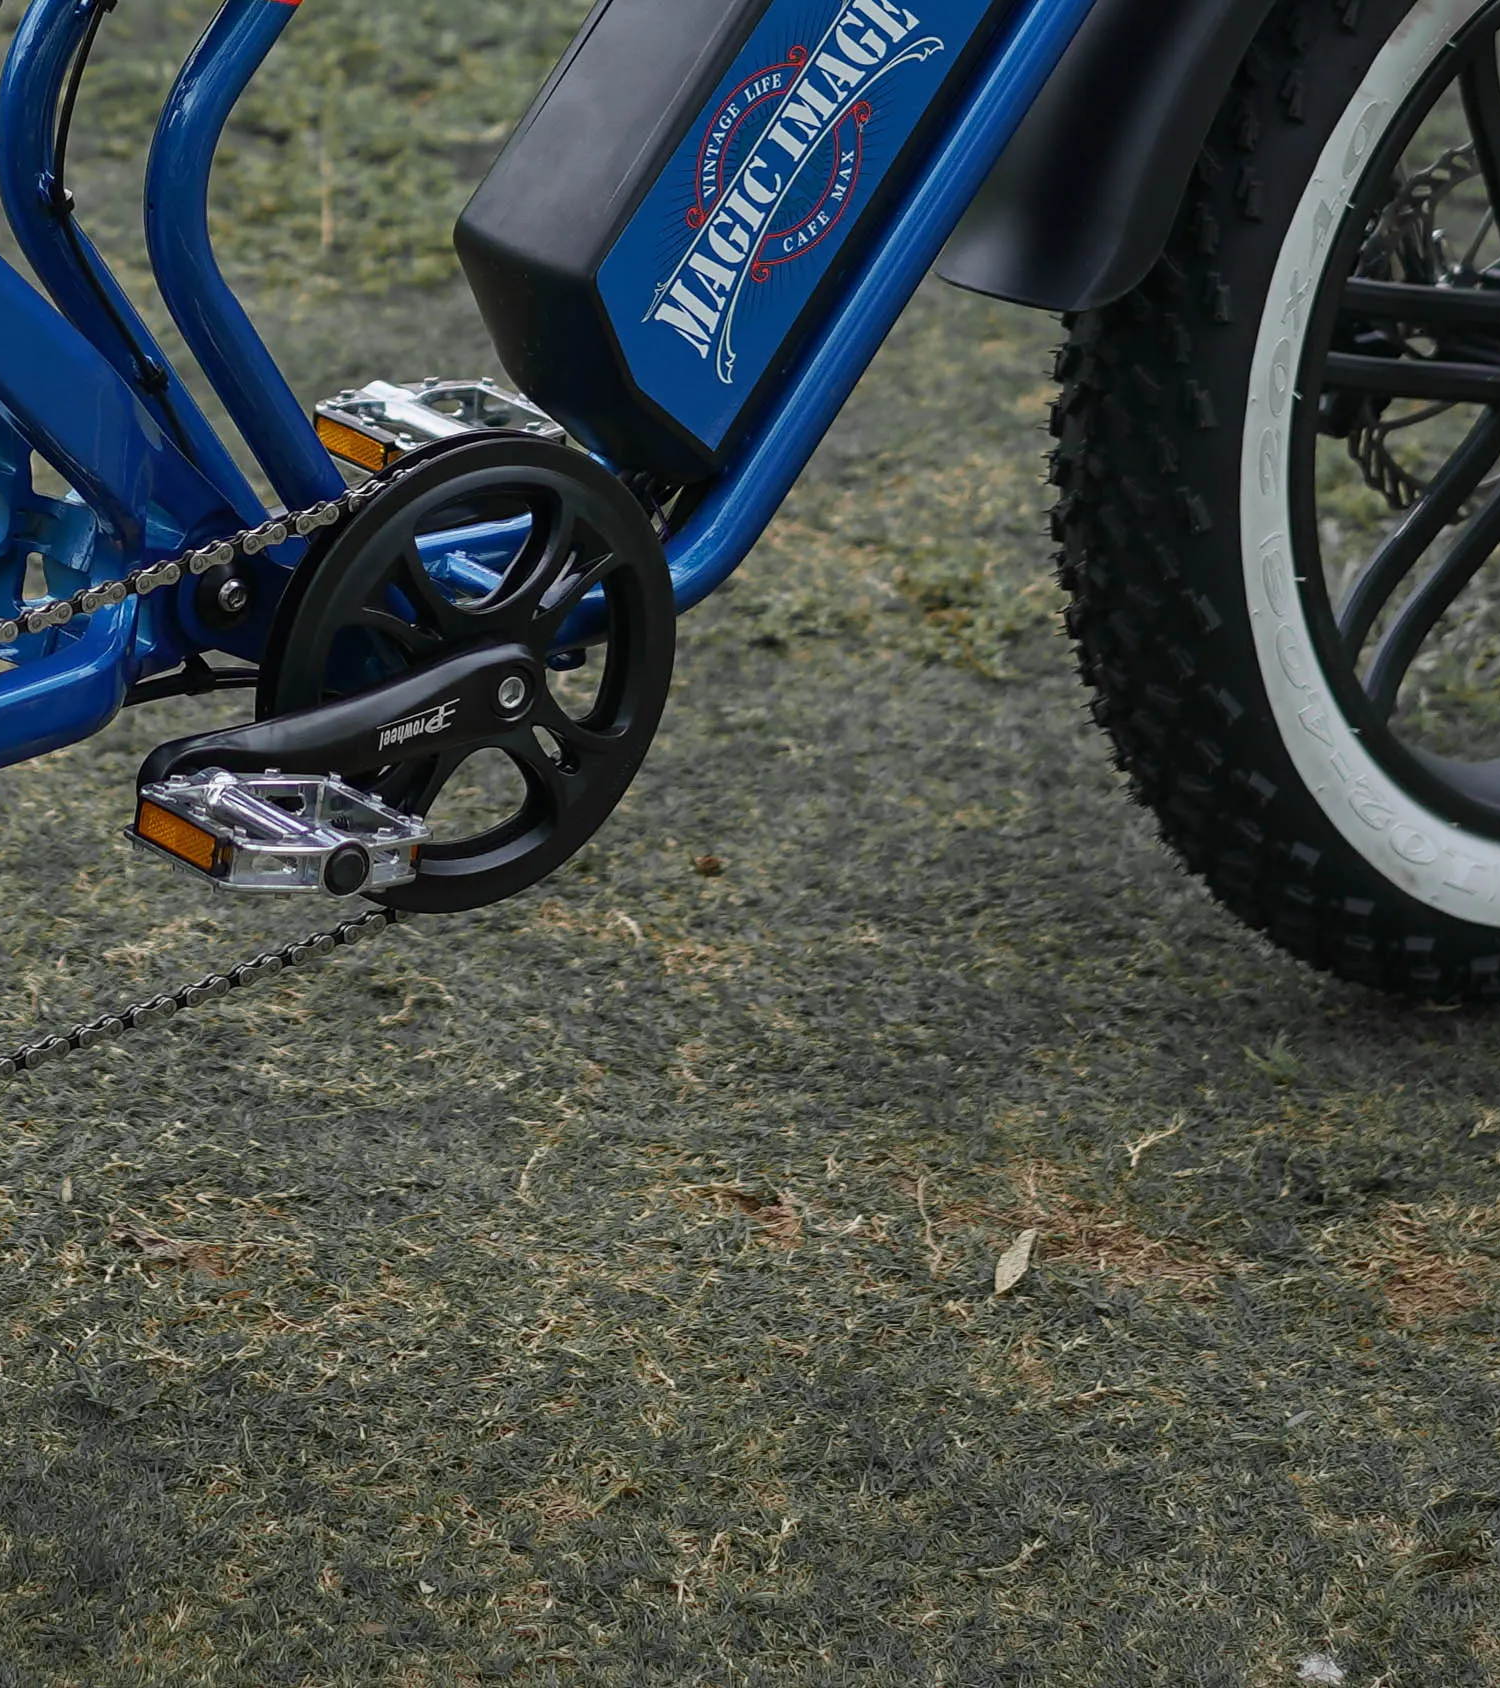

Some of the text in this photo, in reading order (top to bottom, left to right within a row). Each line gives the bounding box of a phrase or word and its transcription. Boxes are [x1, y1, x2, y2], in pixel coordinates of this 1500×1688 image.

[702, 72, 783, 197] VINTAGE LIFE
[654, 155, 783, 359] MAGIC
[783, 150, 855, 253] CAFE MAX
[377, 698, 460, 751] Prowheel
